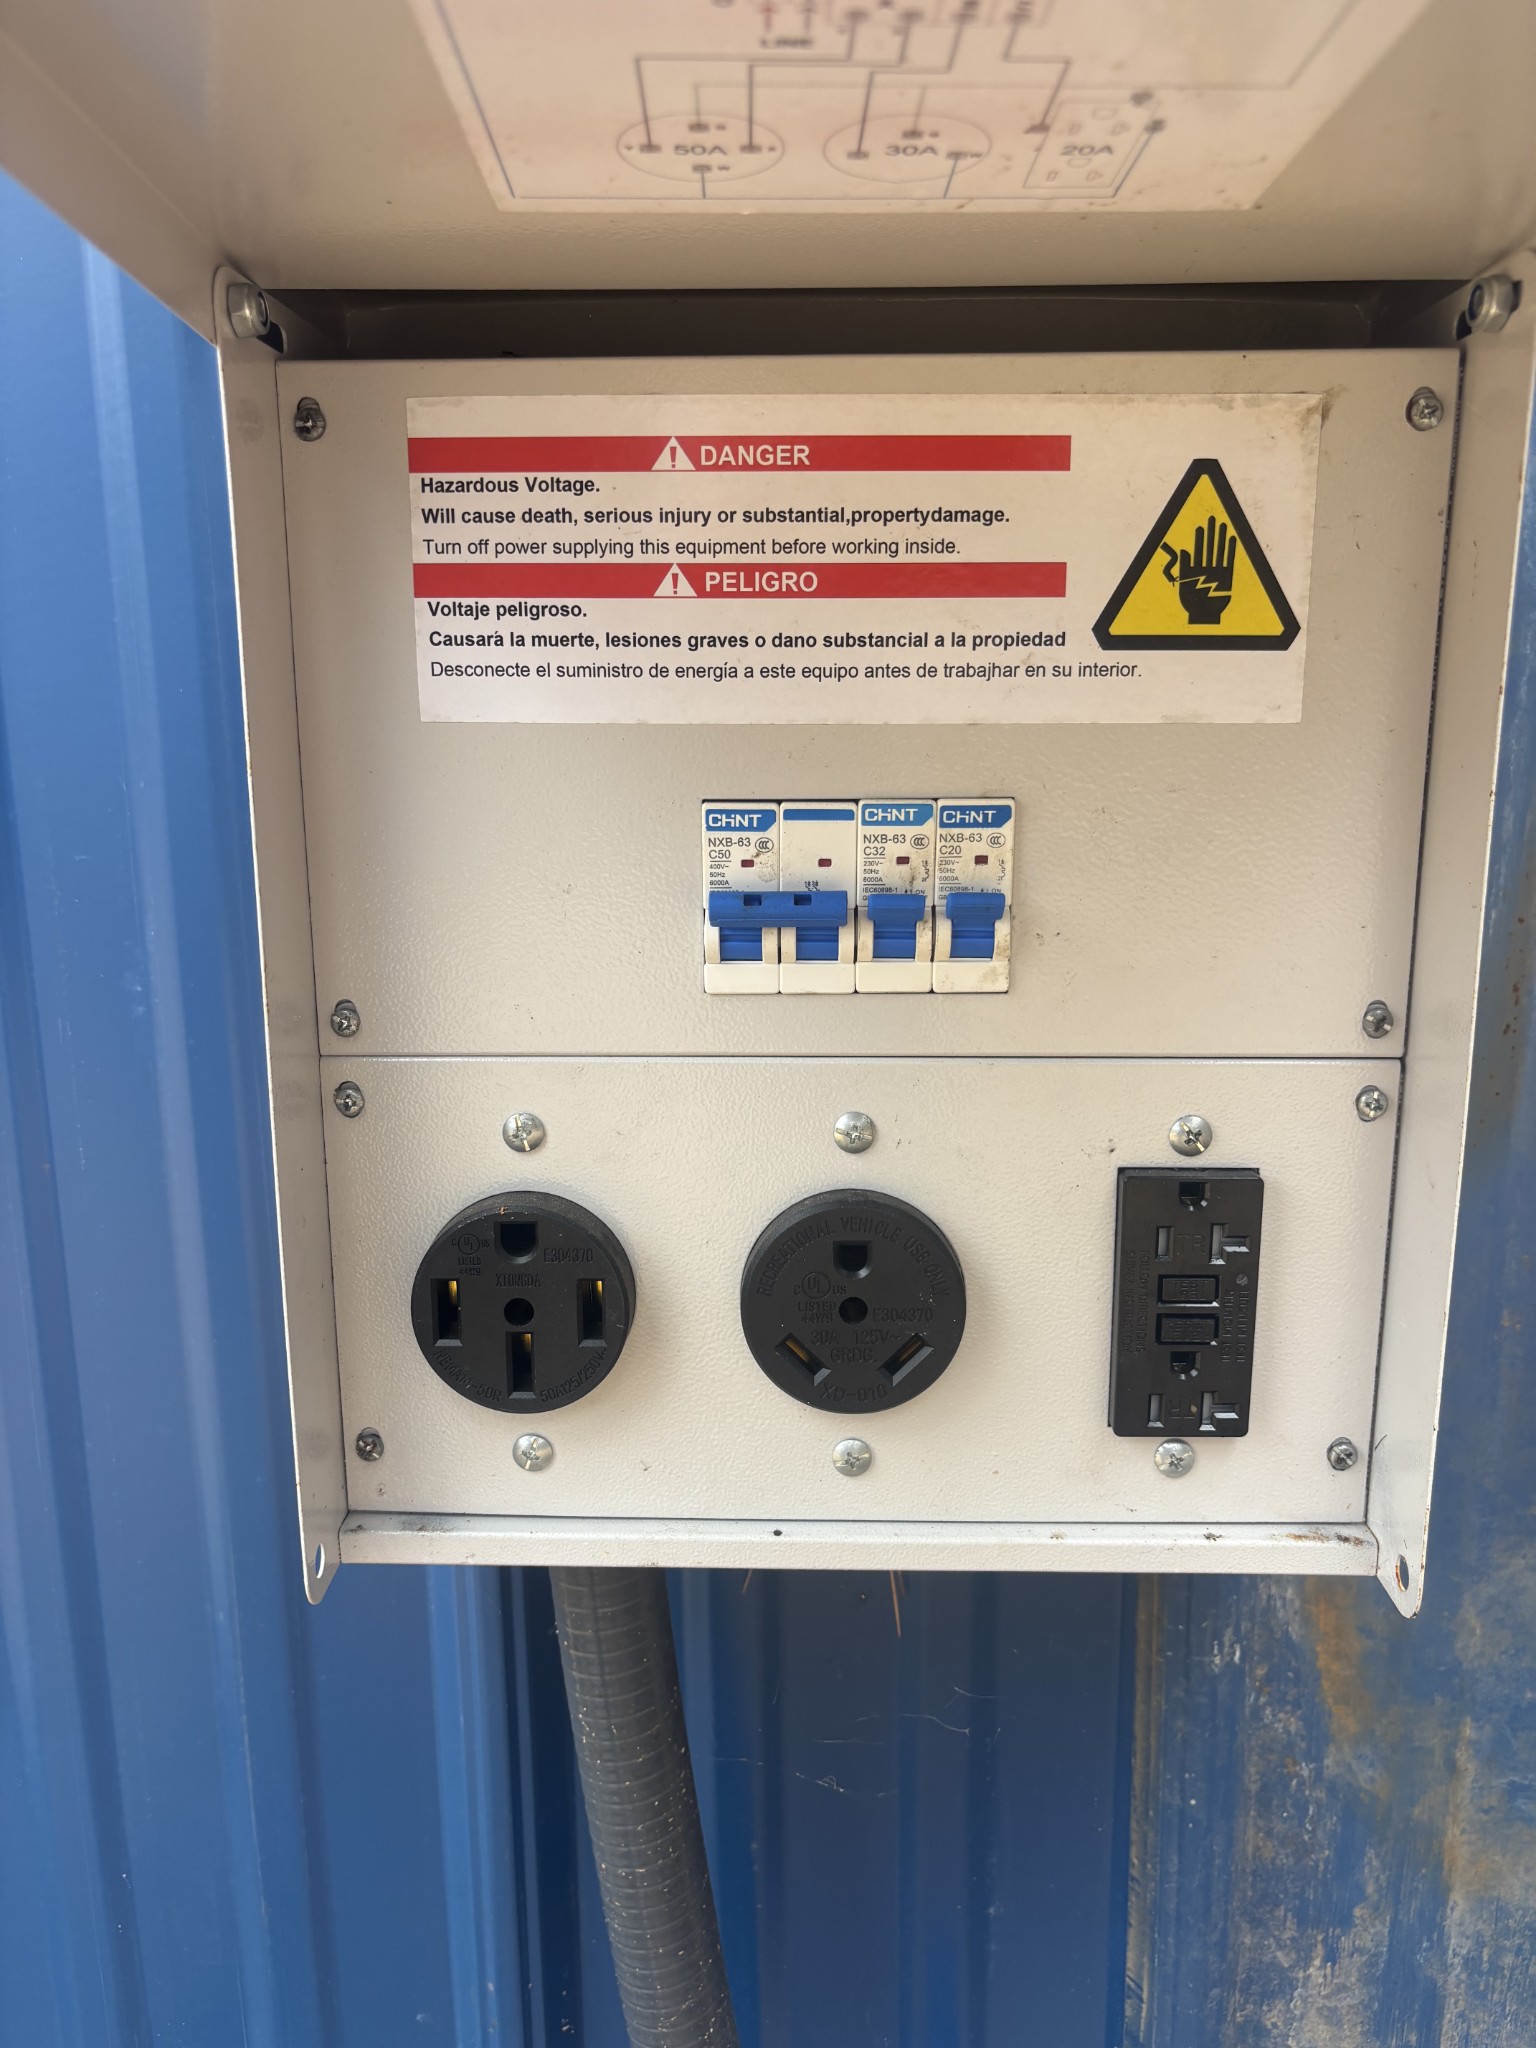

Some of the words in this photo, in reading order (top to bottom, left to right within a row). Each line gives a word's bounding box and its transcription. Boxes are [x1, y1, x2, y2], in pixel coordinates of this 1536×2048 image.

[673, 145, 728, 156] 50A
[885, 145, 938, 157] 30A
[1060, 144, 1114, 156] 20A
[700, 445, 809, 466] DANGER
[421, 477, 519, 493] Hazardous
[524, 477, 600, 496] Voltage.
[421, 508, 455, 524] Will
[461, 511, 516, 524] cause
[521, 508, 578, 527] death,
[583, 508, 653, 524] serious
[659, 507, 712, 527] injury
[717, 511, 737, 524] or
[423, 539, 461, 555] Turn
[467, 539, 490, 555] off
[495, 542, 547, 558] power
[552, 539, 634, 558] supplying
[640, 539, 670, 555] this
[675, 539, 767, 558] equipment
[771, 539, 827, 555] before
[832, 538, 899, 558] working
[905, 538, 961, 554] inside.
[705, 571, 818, 592] PELIGRO
[427, 601, 490, 620] Voltaje
[496, 601, 587, 621] peligroso.
[429, 631, 504, 648] Causará
[510, 632, 526, 647] la
[531, 632, 600, 651] muerte,
[605, 632, 682, 648] lesiones
[687, 635, 749, 651] graves
[755, 636, 766, 648] o
[771, 632, 818, 648] dano
[822, 632, 928, 648] substancial
[934, 635, 945, 648] a
[951, 632, 966, 648] la
[971, 631, 1067, 651] propiedad
[430, 662, 530, 678] Desconecte
[536, 662, 551, 678] el
[556, 662, 643, 678] suministro
[649, 662, 669, 678] de
[675, 662, 738, 682] energía
[743, 666, 754, 678] a
[760, 664, 795, 678] este
[801, 662, 859, 682] equipo
[864, 663, 911, 678] antes
[916, 662, 937, 678] de
[943, 662, 1020, 682] trabajhar
[1025, 665, 1046, 678] en
[1051, 665, 1072, 678] su
[1078, 662, 1142, 677] interior.
[708, 837, 751, 847] NXB-63
[863, 834, 906, 844] NXB-63
[939, 833, 982, 843] NXB-63
[708, 849, 731, 859] C50
[863, 846, 886, 856] C32
[939, 845, 962, 855] C20
[458, 1256, 482, 1266] LISTED
[543, 1249, 594, 1263] E304370
[756, 1219, 836, 1297] RECREATIONAL
[840, 1216, 903, 1244] VEHICLE
[904, 1234, 926, 1265] USE
[832, 1285, 847, 1296] US
[797, 1302, 836, 1312] LISTED
[873, 1308, 934, 1323] E304370
[811, 1329, 840, 1345] 30A
